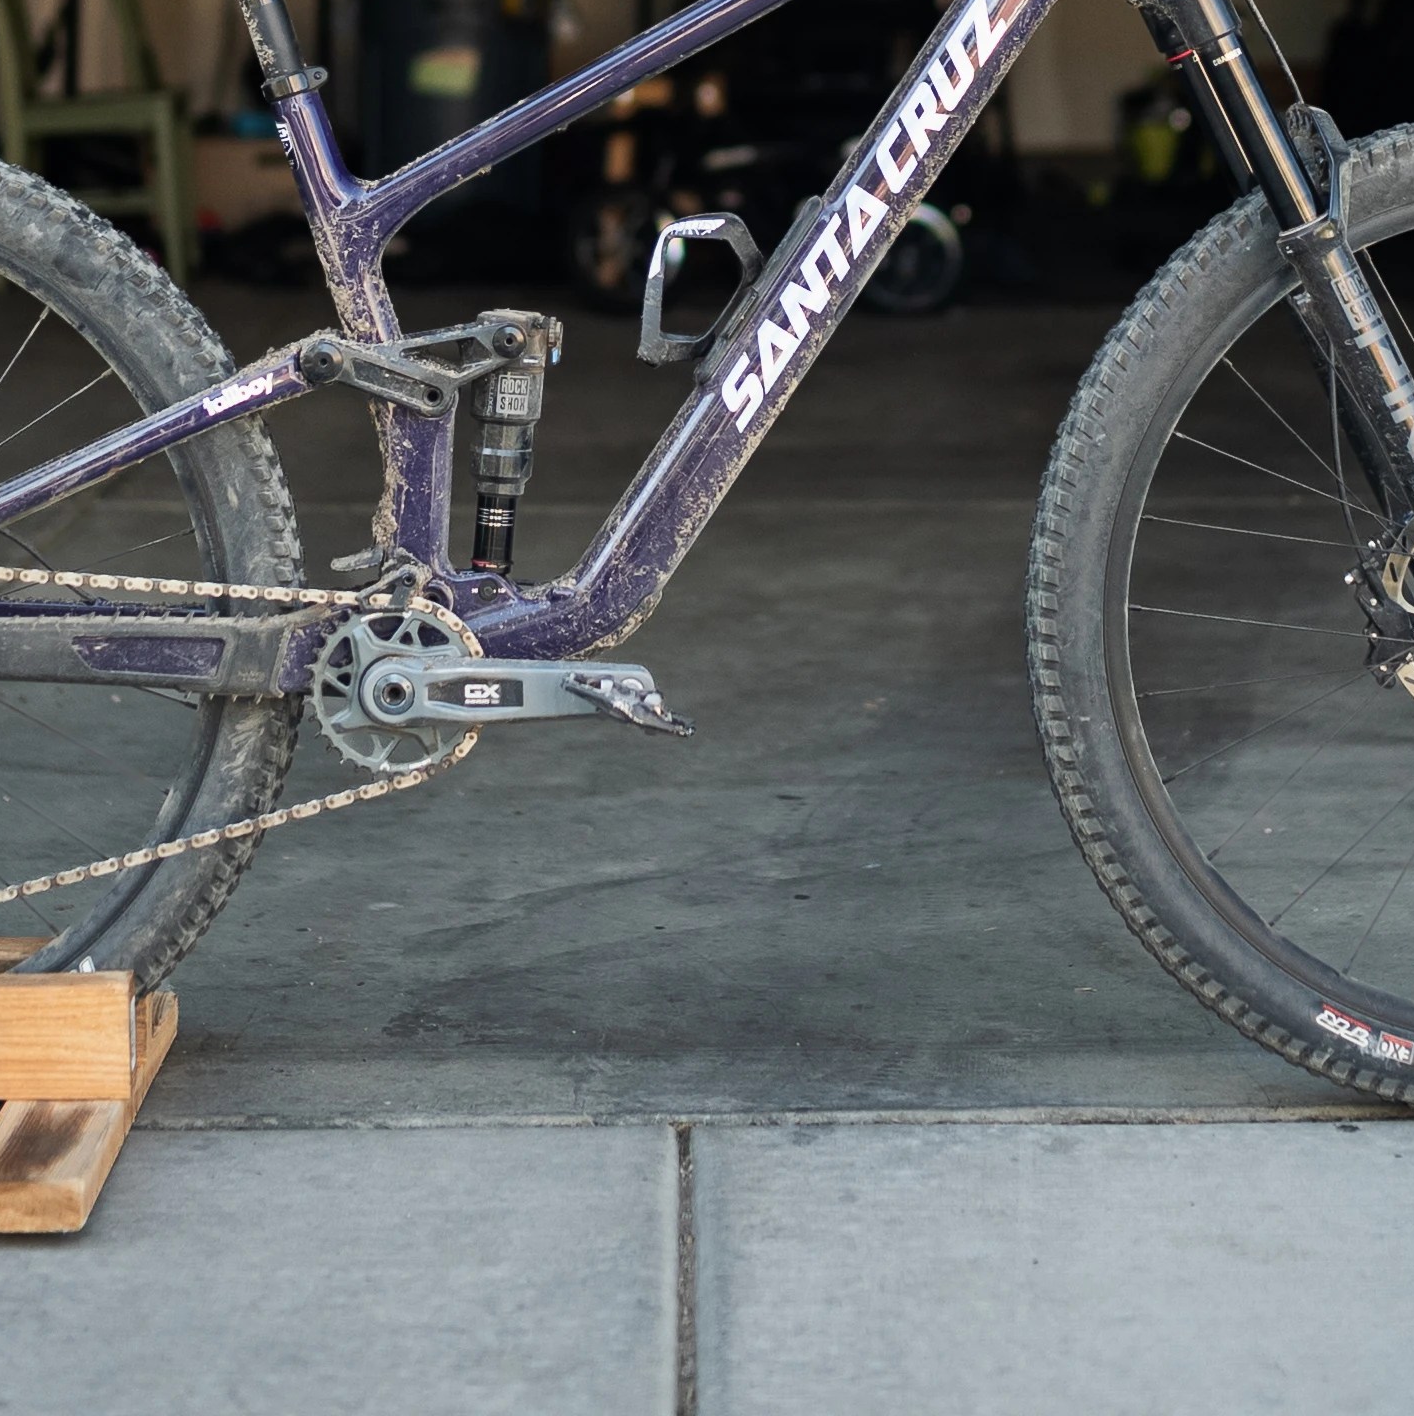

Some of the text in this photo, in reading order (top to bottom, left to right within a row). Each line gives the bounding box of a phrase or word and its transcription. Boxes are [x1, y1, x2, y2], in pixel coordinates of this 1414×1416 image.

[721, 184, 890, 433] SANTA
[203, 372, 274, 417] tallboy
[501, 378, 528, 394] ROCK
[499, 396, 526, 412] SHOX
[465, 684, 500, 698] GX
[1380, 1039, 1411, 1062] EXO
